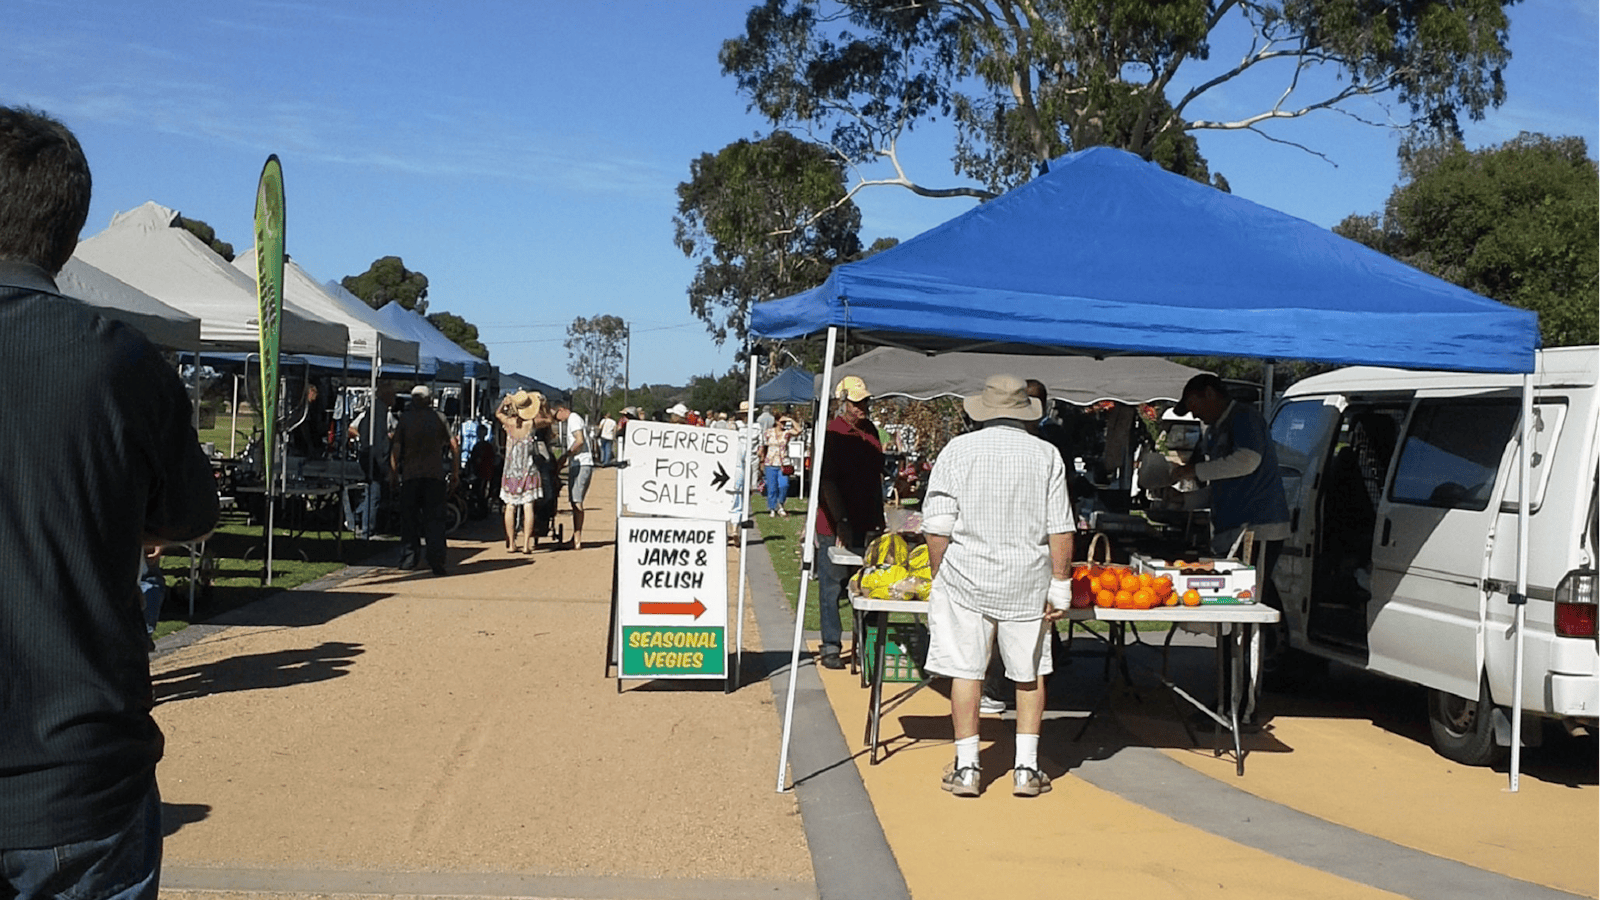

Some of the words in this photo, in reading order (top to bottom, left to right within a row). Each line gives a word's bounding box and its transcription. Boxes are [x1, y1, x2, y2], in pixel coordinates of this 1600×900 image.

[655, 457, 699, 479] FOR
[639, 480, 698, 506] SALE
[628, 528, 716, 545] HOMEMADE
[637, 548, 690, 567] JAMS
[694, 549, 708, 567] &
[640, 571, 704, 589] RELISH
[628, 631, 718, 648] SEASONAL
[643, 651, 704, 670] VEGIES
